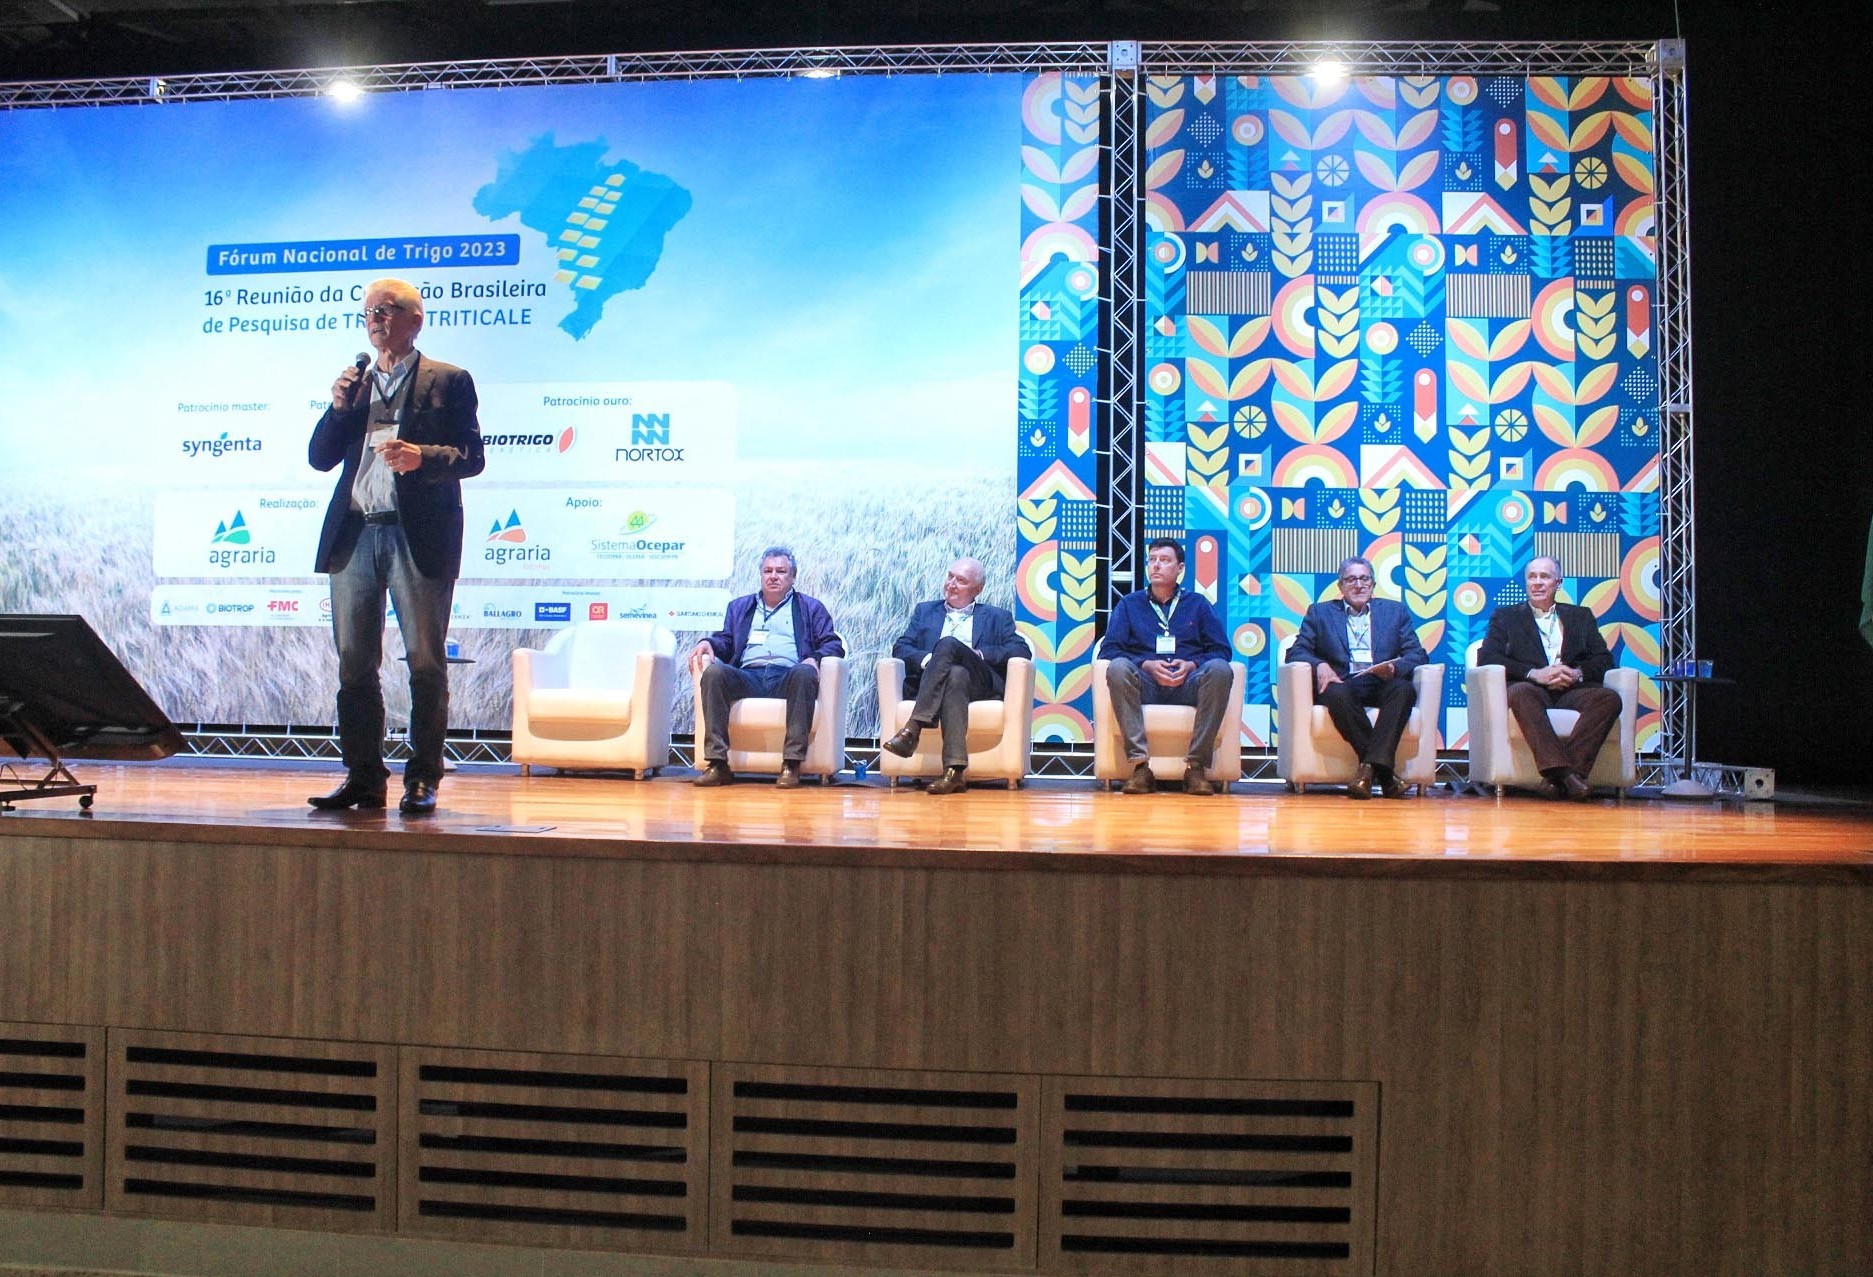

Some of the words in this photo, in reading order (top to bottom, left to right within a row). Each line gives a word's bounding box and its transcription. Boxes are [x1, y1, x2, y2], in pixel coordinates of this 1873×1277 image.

[218, 248, 277, 266] Fórum
[283, 245, 368, 264] Nacional
[375, 244, 396, 261] de
[403, 242, 453, 264] Trigo
[459, 240, 506, 258] 2023
[236, 285, 314, 305] Reunião
[320, 285, 344, 303] da
[451, 279, 547, 299] Brasileira
[426, 308, 532, 327] TRITICALE
[203, 317, 224, 334] de
[228, 314, 310, 336] Pesquisa
[315, 315, 338, 330] de
[177, 401, 229, 412] Patrocínio
[543, 396, 600, 407] Patrocínio
[603, 397, 632, 406] ouro:
[482, 433, 554, 446] BIOTRIGO
[182, 437, 262, 457] syngenta
[259, 497, 319, 510] Realização:
[565, 496, 603, 509] Apoio:
[591, 539, 686, 553] SistemaOcepar
[209, 546, 276, 568] agraria
[484, 544, 551, 565] agraria
[218, 604, 254, 614] BIOTROP
[266, 600, 299, 612] FMC
[483, 610, 522, 618] BALLAGRO
